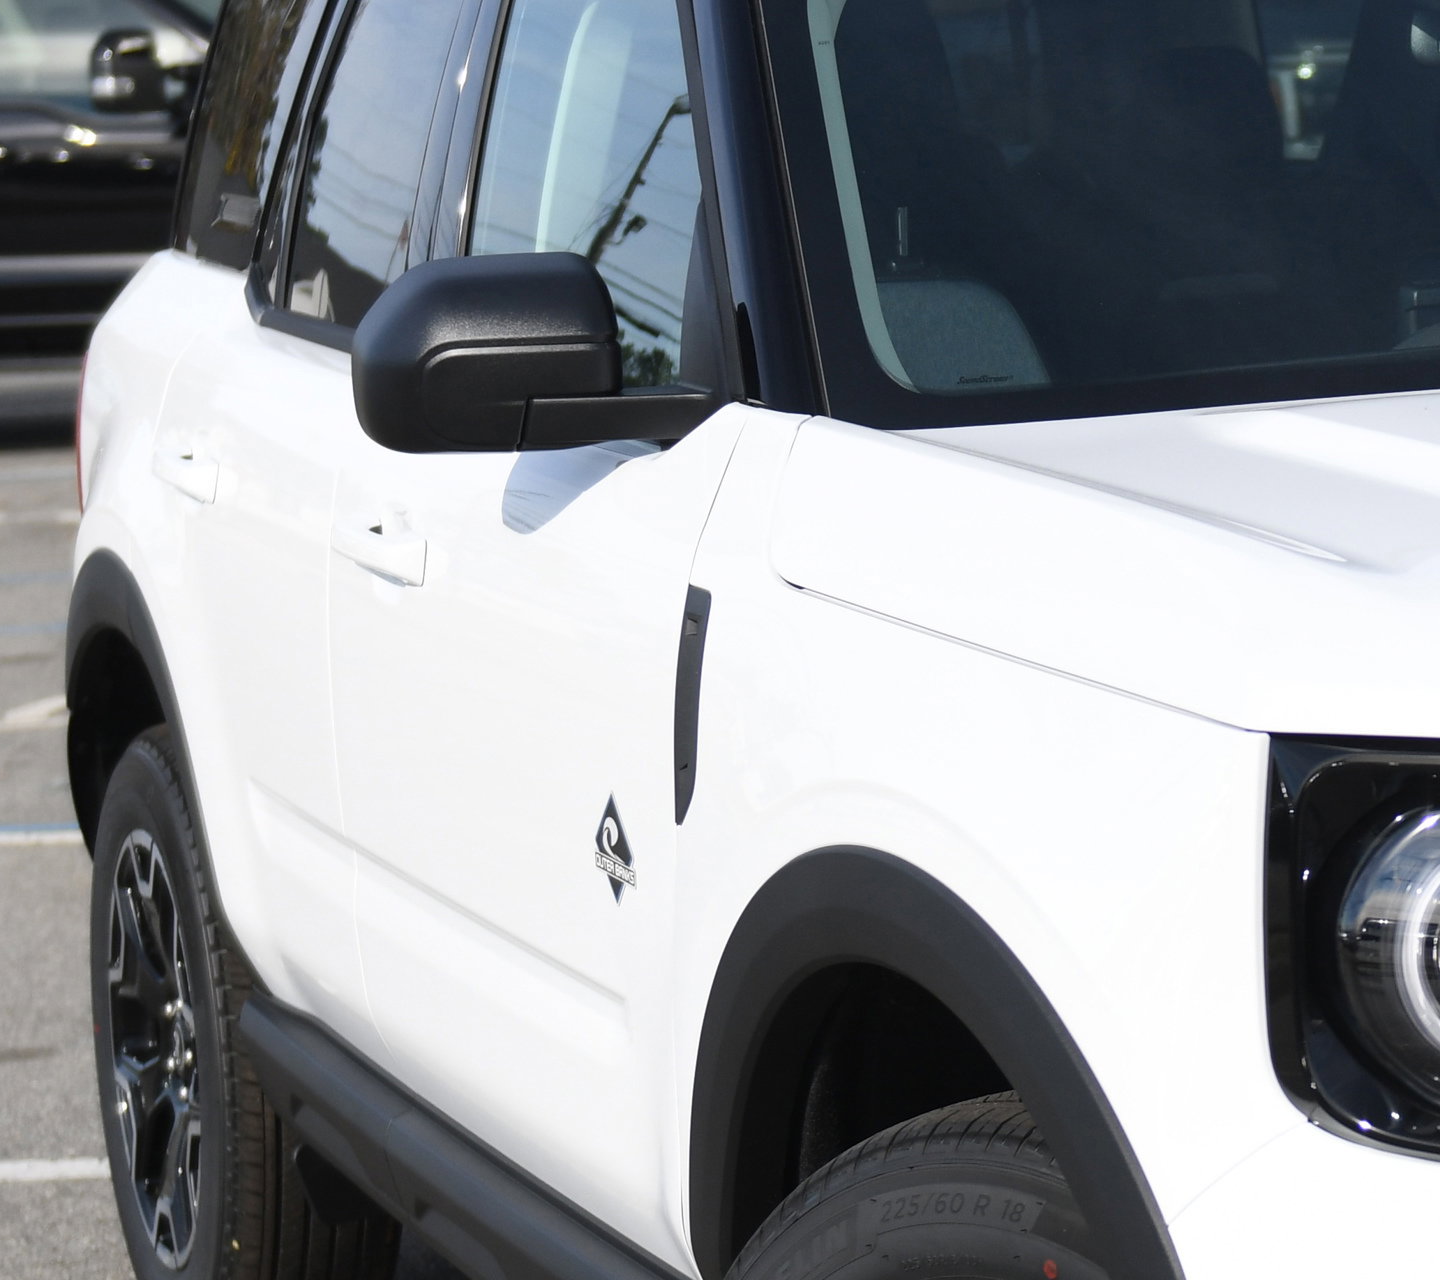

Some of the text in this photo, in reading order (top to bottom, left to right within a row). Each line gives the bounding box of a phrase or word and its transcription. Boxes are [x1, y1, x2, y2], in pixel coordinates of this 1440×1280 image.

[596, 853, 635, 886] OUTER BANKS
[880, 1192, 1026, 1223] 225/60 R 18
